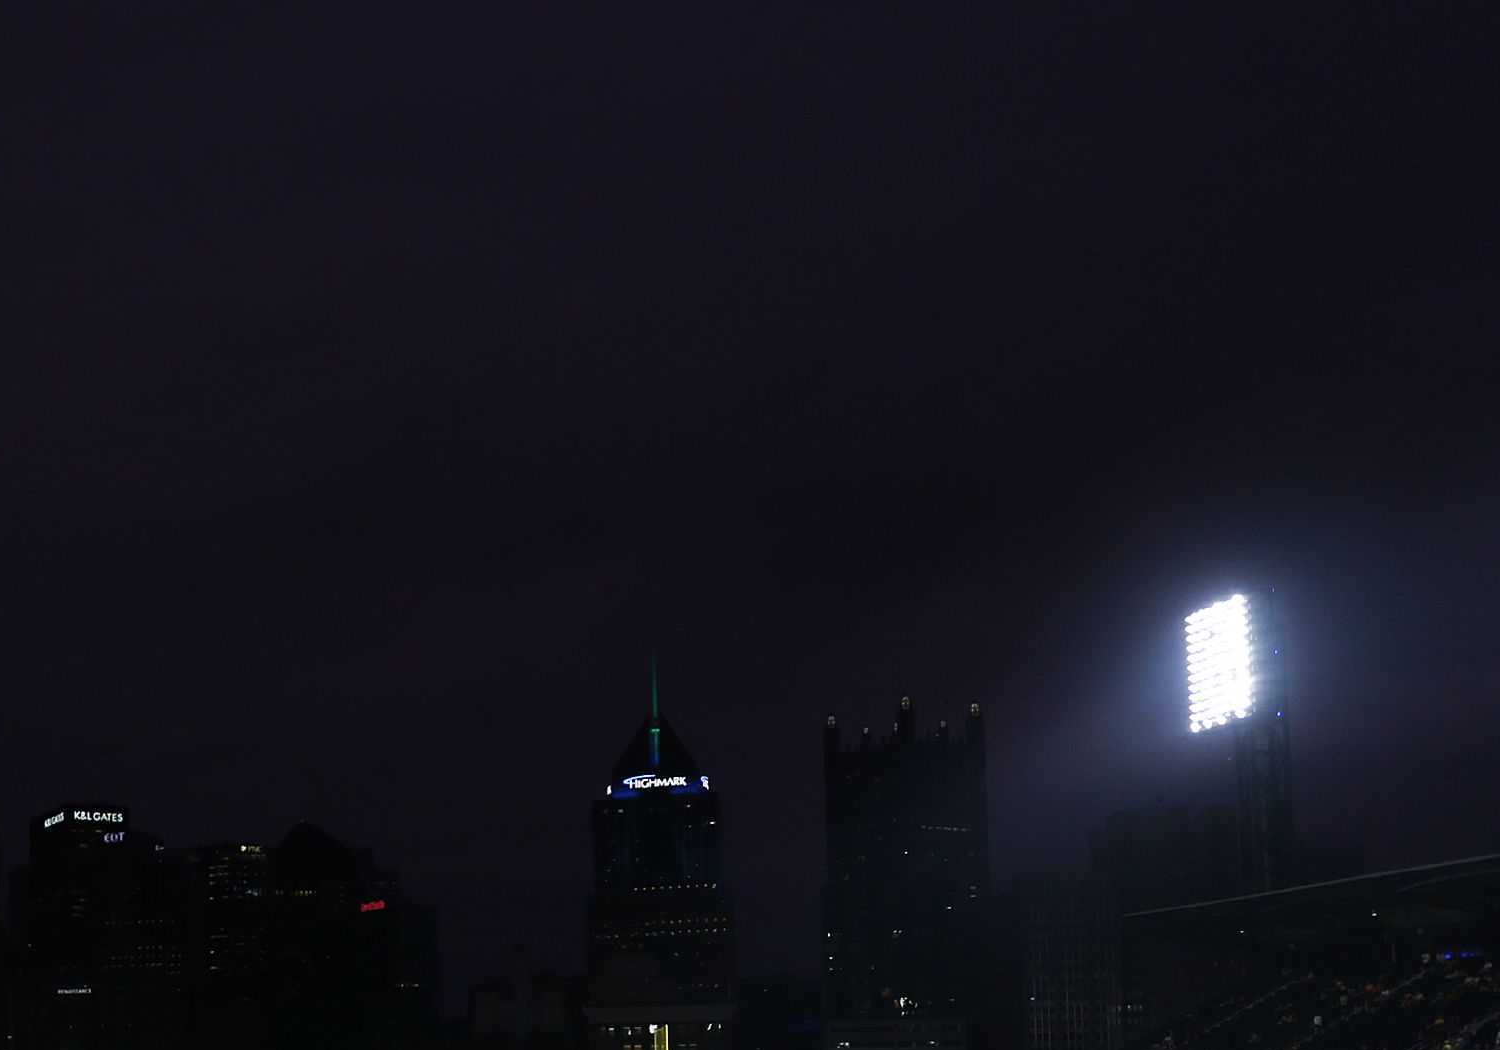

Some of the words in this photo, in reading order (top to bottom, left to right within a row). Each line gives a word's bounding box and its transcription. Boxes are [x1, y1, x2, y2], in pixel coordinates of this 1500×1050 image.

[626, 774, 687, 789] HIGHMARK
[73, 811, 92, 821] K&L
[93, 812, 124, 823] GATES
